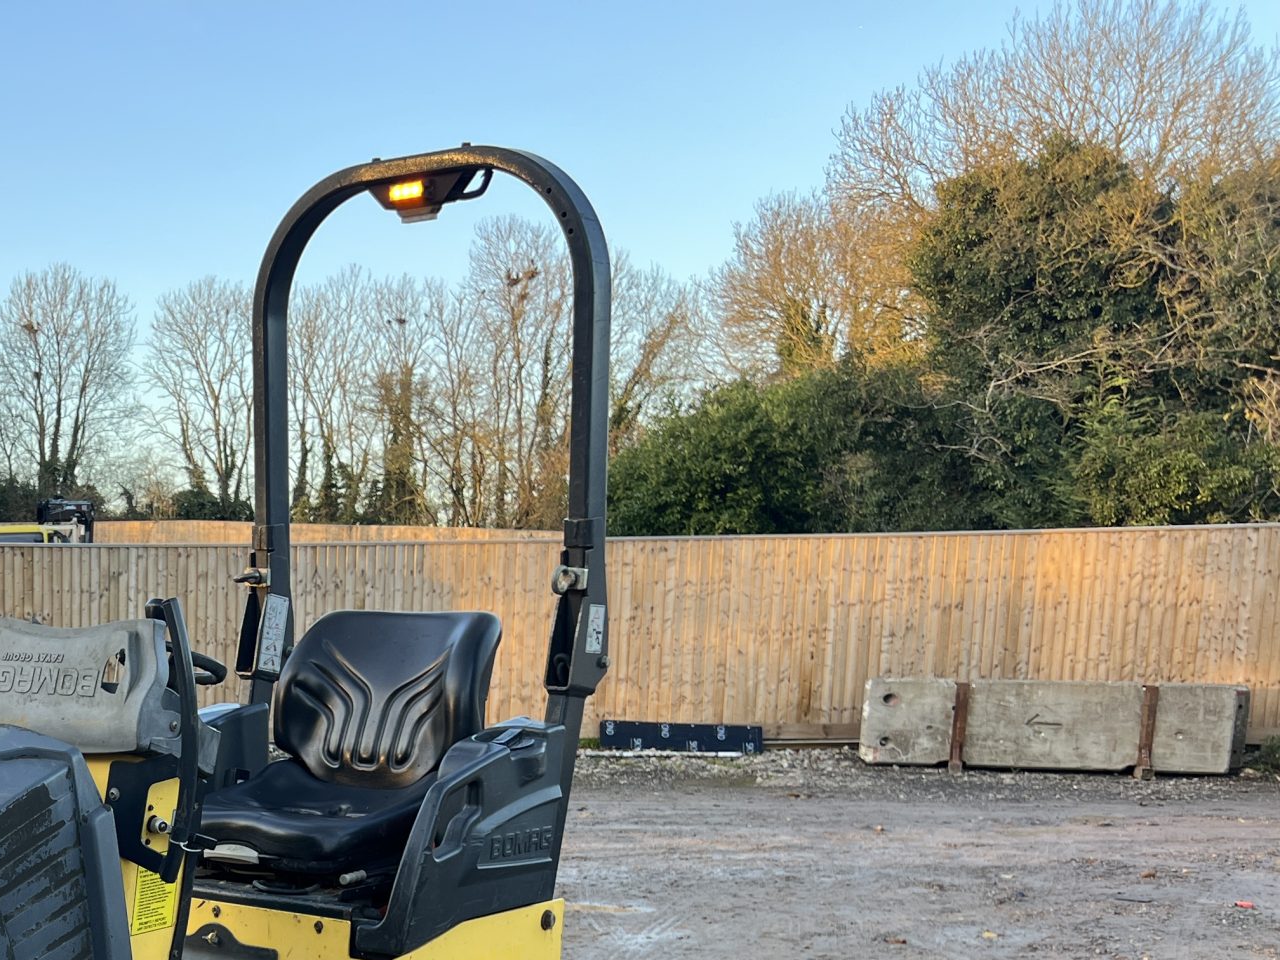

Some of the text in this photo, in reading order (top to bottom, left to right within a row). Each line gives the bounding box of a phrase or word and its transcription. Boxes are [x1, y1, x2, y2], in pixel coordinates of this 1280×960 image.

[0, 651, 65, 664] FAYAT GROUP
[489, 825, 552, 861] BOMAG
